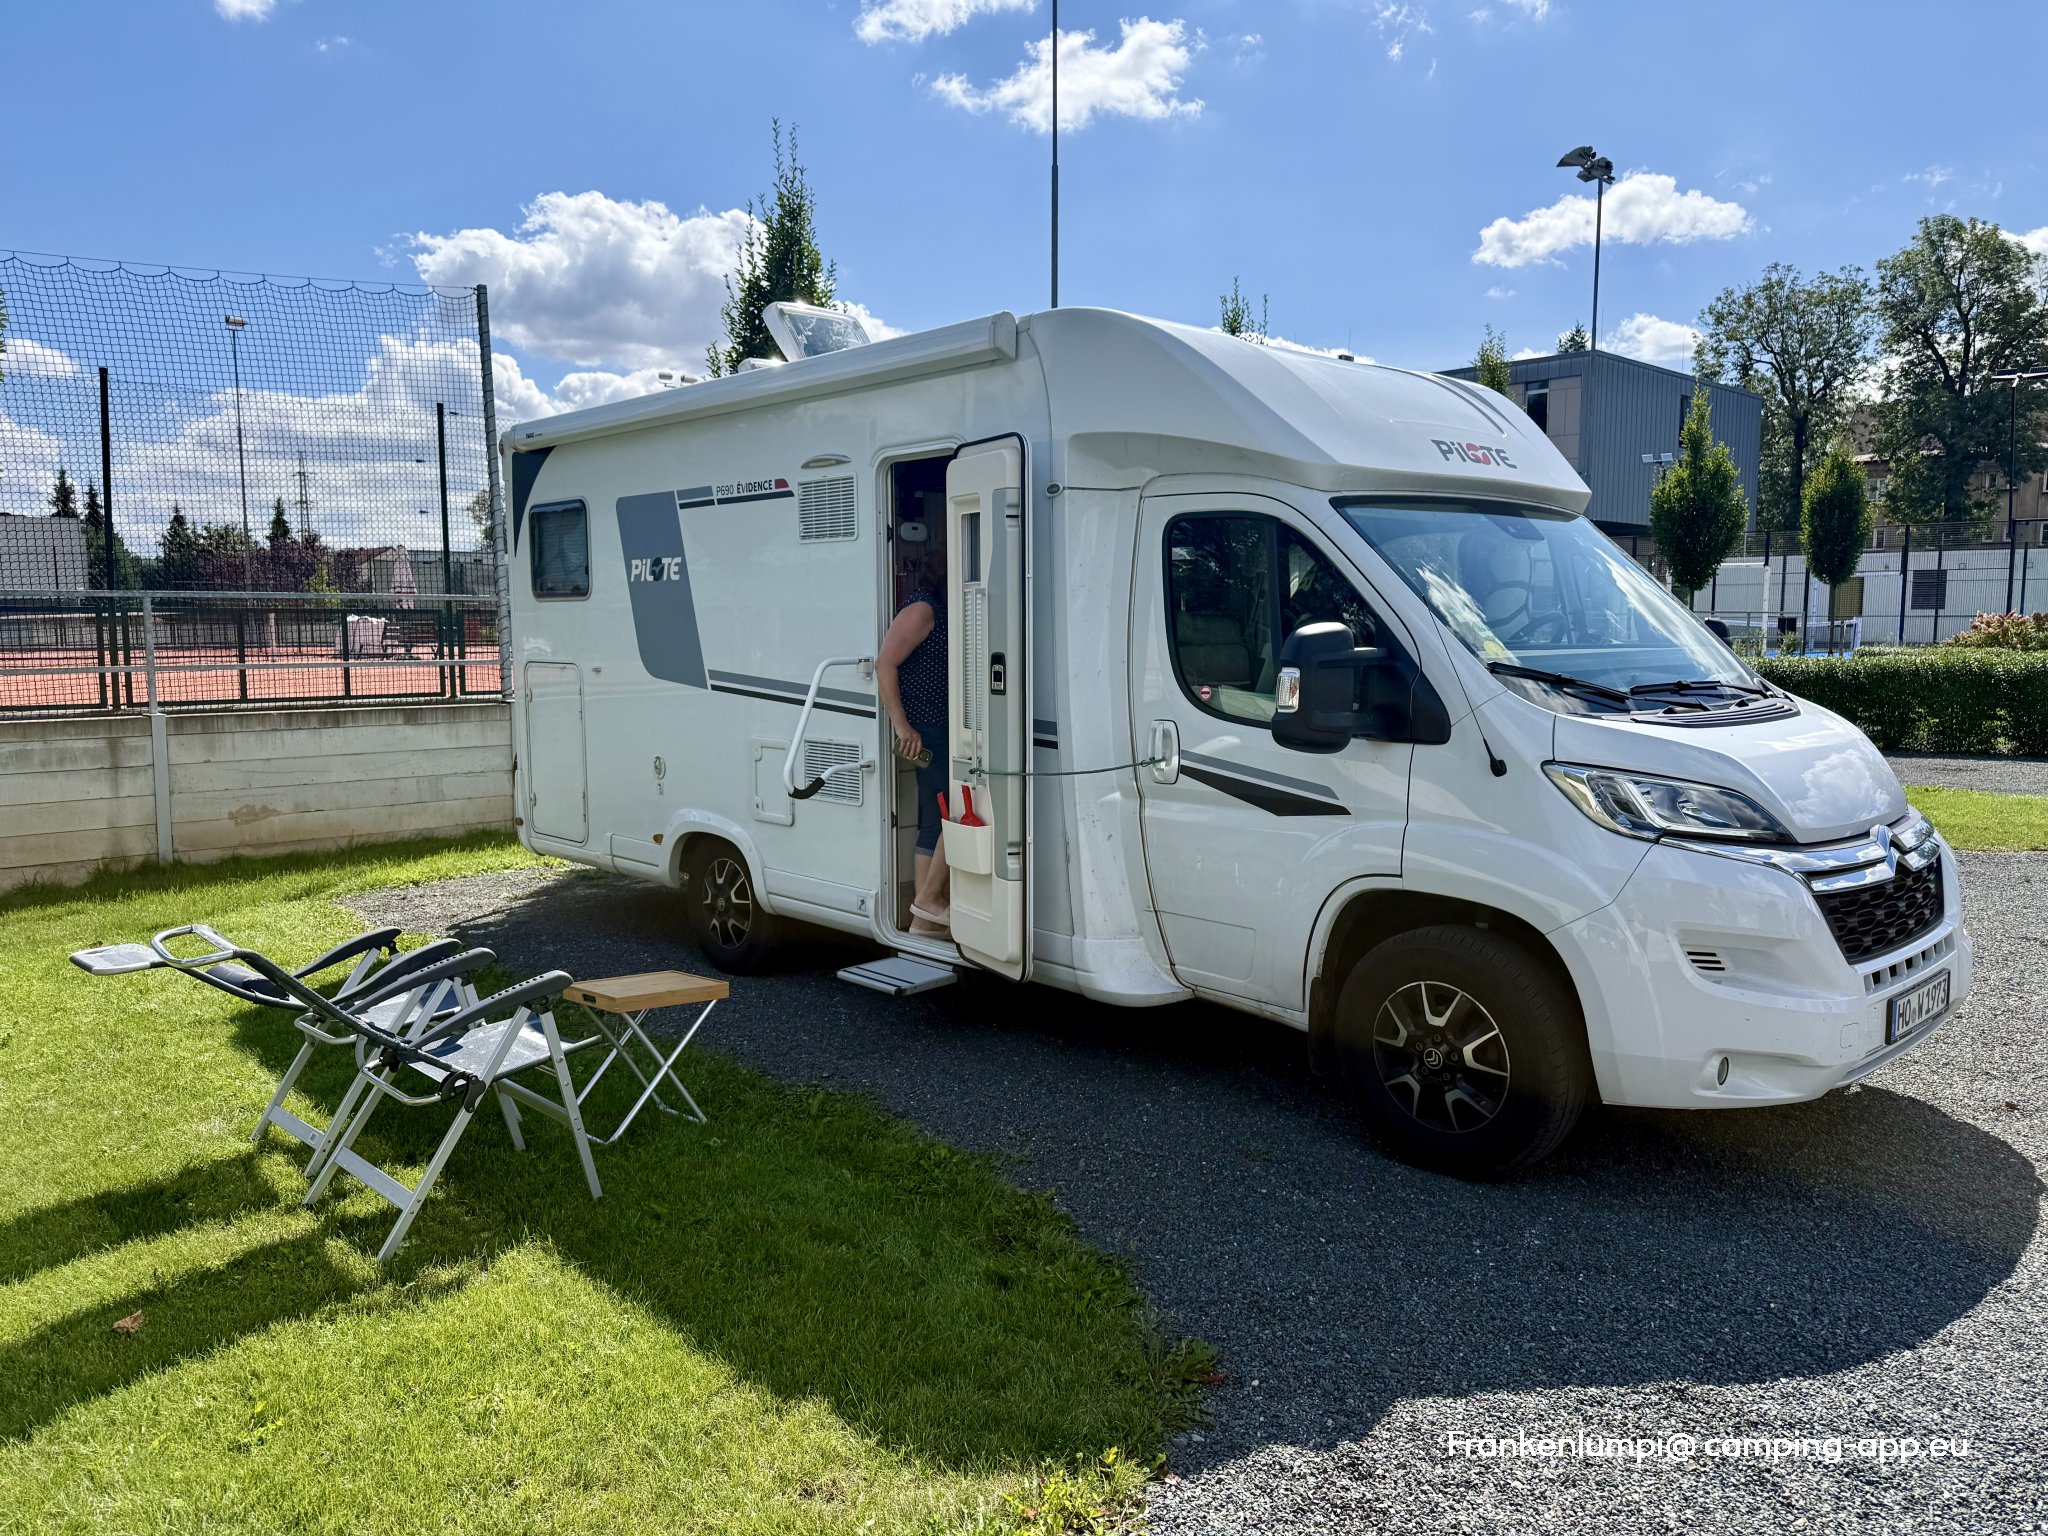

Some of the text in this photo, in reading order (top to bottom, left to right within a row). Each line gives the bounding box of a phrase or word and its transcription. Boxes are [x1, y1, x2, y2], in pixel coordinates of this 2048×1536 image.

[716, 479, 773, 496] P690 ÉVIDENCE
[1897, 998, 1912, 1032] HO
[1925, 978, 1947, 1014] 1973
